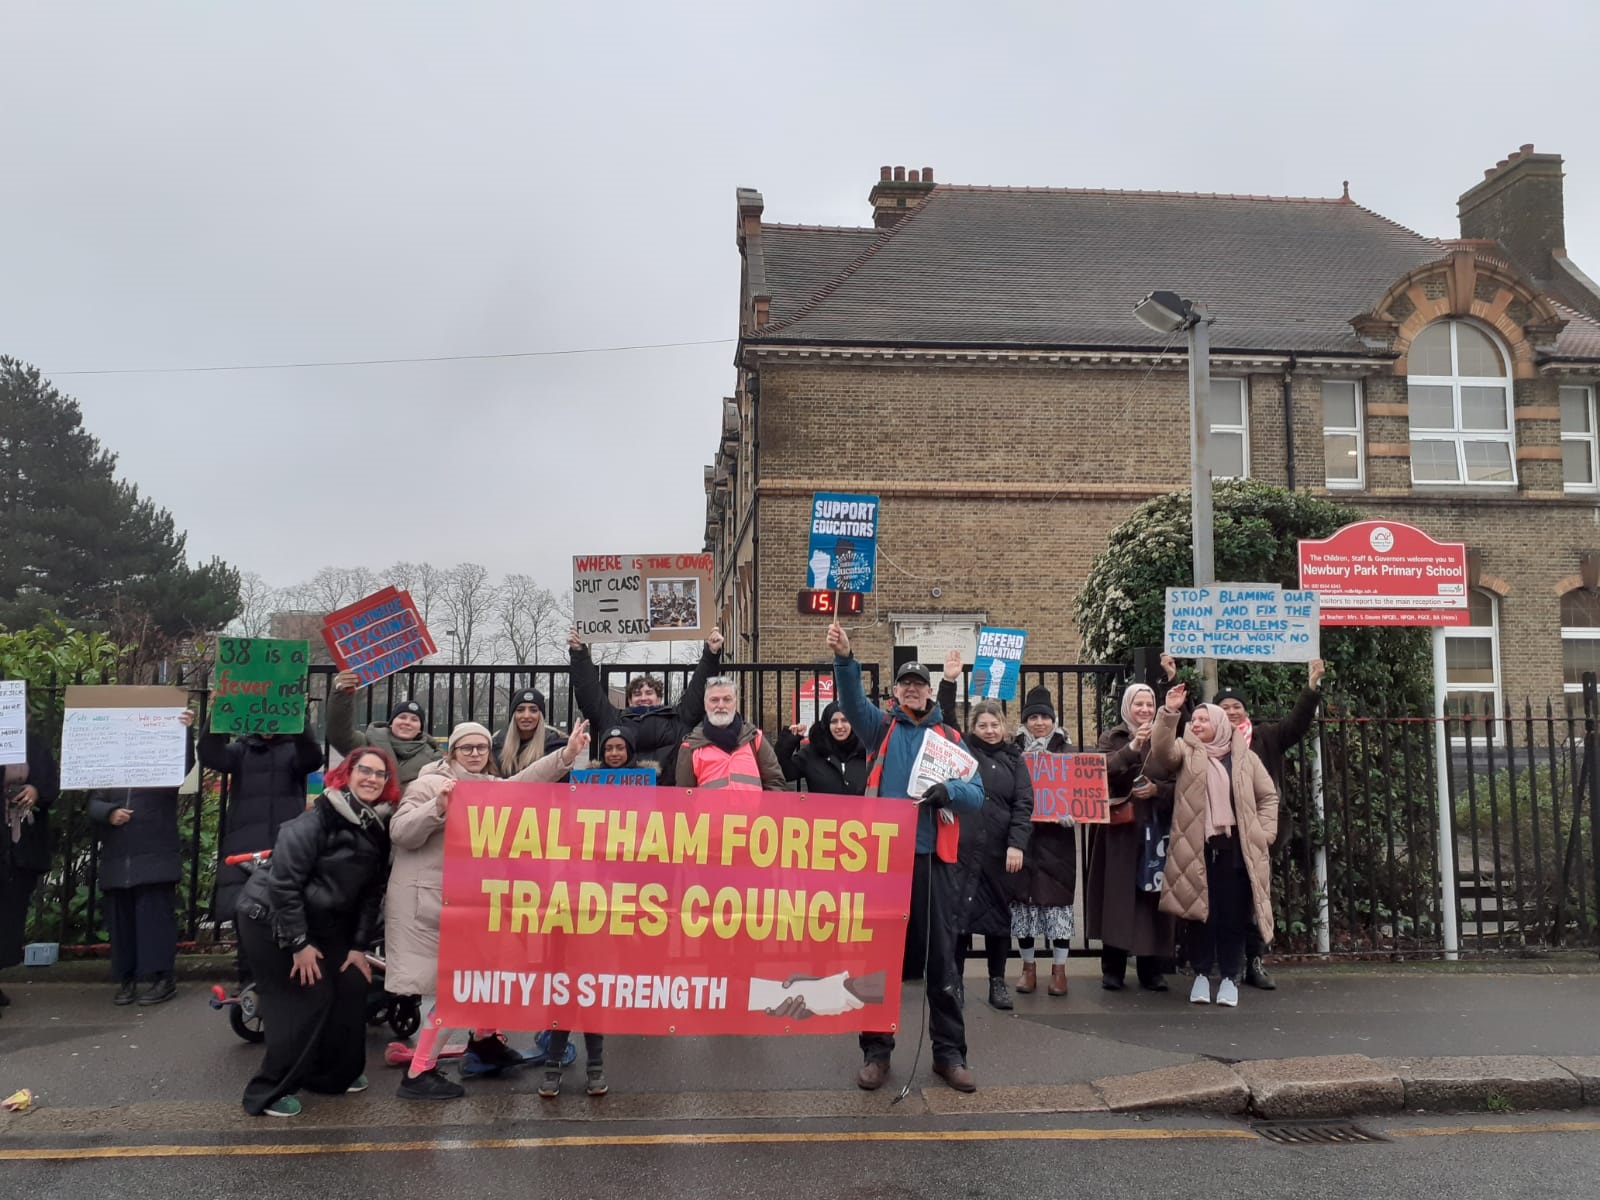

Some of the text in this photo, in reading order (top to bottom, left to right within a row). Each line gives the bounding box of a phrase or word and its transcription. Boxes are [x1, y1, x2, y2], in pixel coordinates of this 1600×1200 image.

[815, 501, 875, 520] SUPPORT
[813, 520, 874, 537] EDUCATORS
[575, 555, 622, 572] WHERE
[632, 559, 643, 569] IS
[647, 557, 672, 569] THE
[1323, 554, 1350, 562] Children,
[831, 567, 871, 575] education
[1303, 564, 1462, 579] Newbury Park Primary School
[574, 576, 640, 593] SPLIT CLASS
[1171, 589, 1315, 603] STOP BLAMING OUR
[1172, 605, 1312, 617] UNION AND FIX THE
[339, 611, 414, 655] TEACHING
[576, 619, 651, 634] FLOOR SEATS
[1172, 620, 1204, 631] REAL
[1215, 620, 1288, 631] PROBLEMS
[980, 632, 1024, 648] DEFEND
[1168, 633, 1309, 643] TOO MUCH WORK, NO
[221, 638, 304, 665] 38 is a
[978, 645, 1021, 659] EDUCATION
[1170, 645, 1276, 655] COVER TEACHERS!
[217, 670, 306, 697] fever not
[222, 697, 300, 716] a class
[230, 714, 280, 733] size
[1023, 753, 1105, 782] TAFF BURN
[1074, 768, 1107, 779] OUT
[620, 775, 651, 786] HERE
[1033, 787, 1102, 819] IDS MISS
[1071, 799, 1108, 819] OUT
[467, 806, 899, 873] WALTHAM FOREST
[481, 879, 874, 943] TRADES COUNCIL
[453, 970, 728, 1009] UNITY IS STRENGTH
